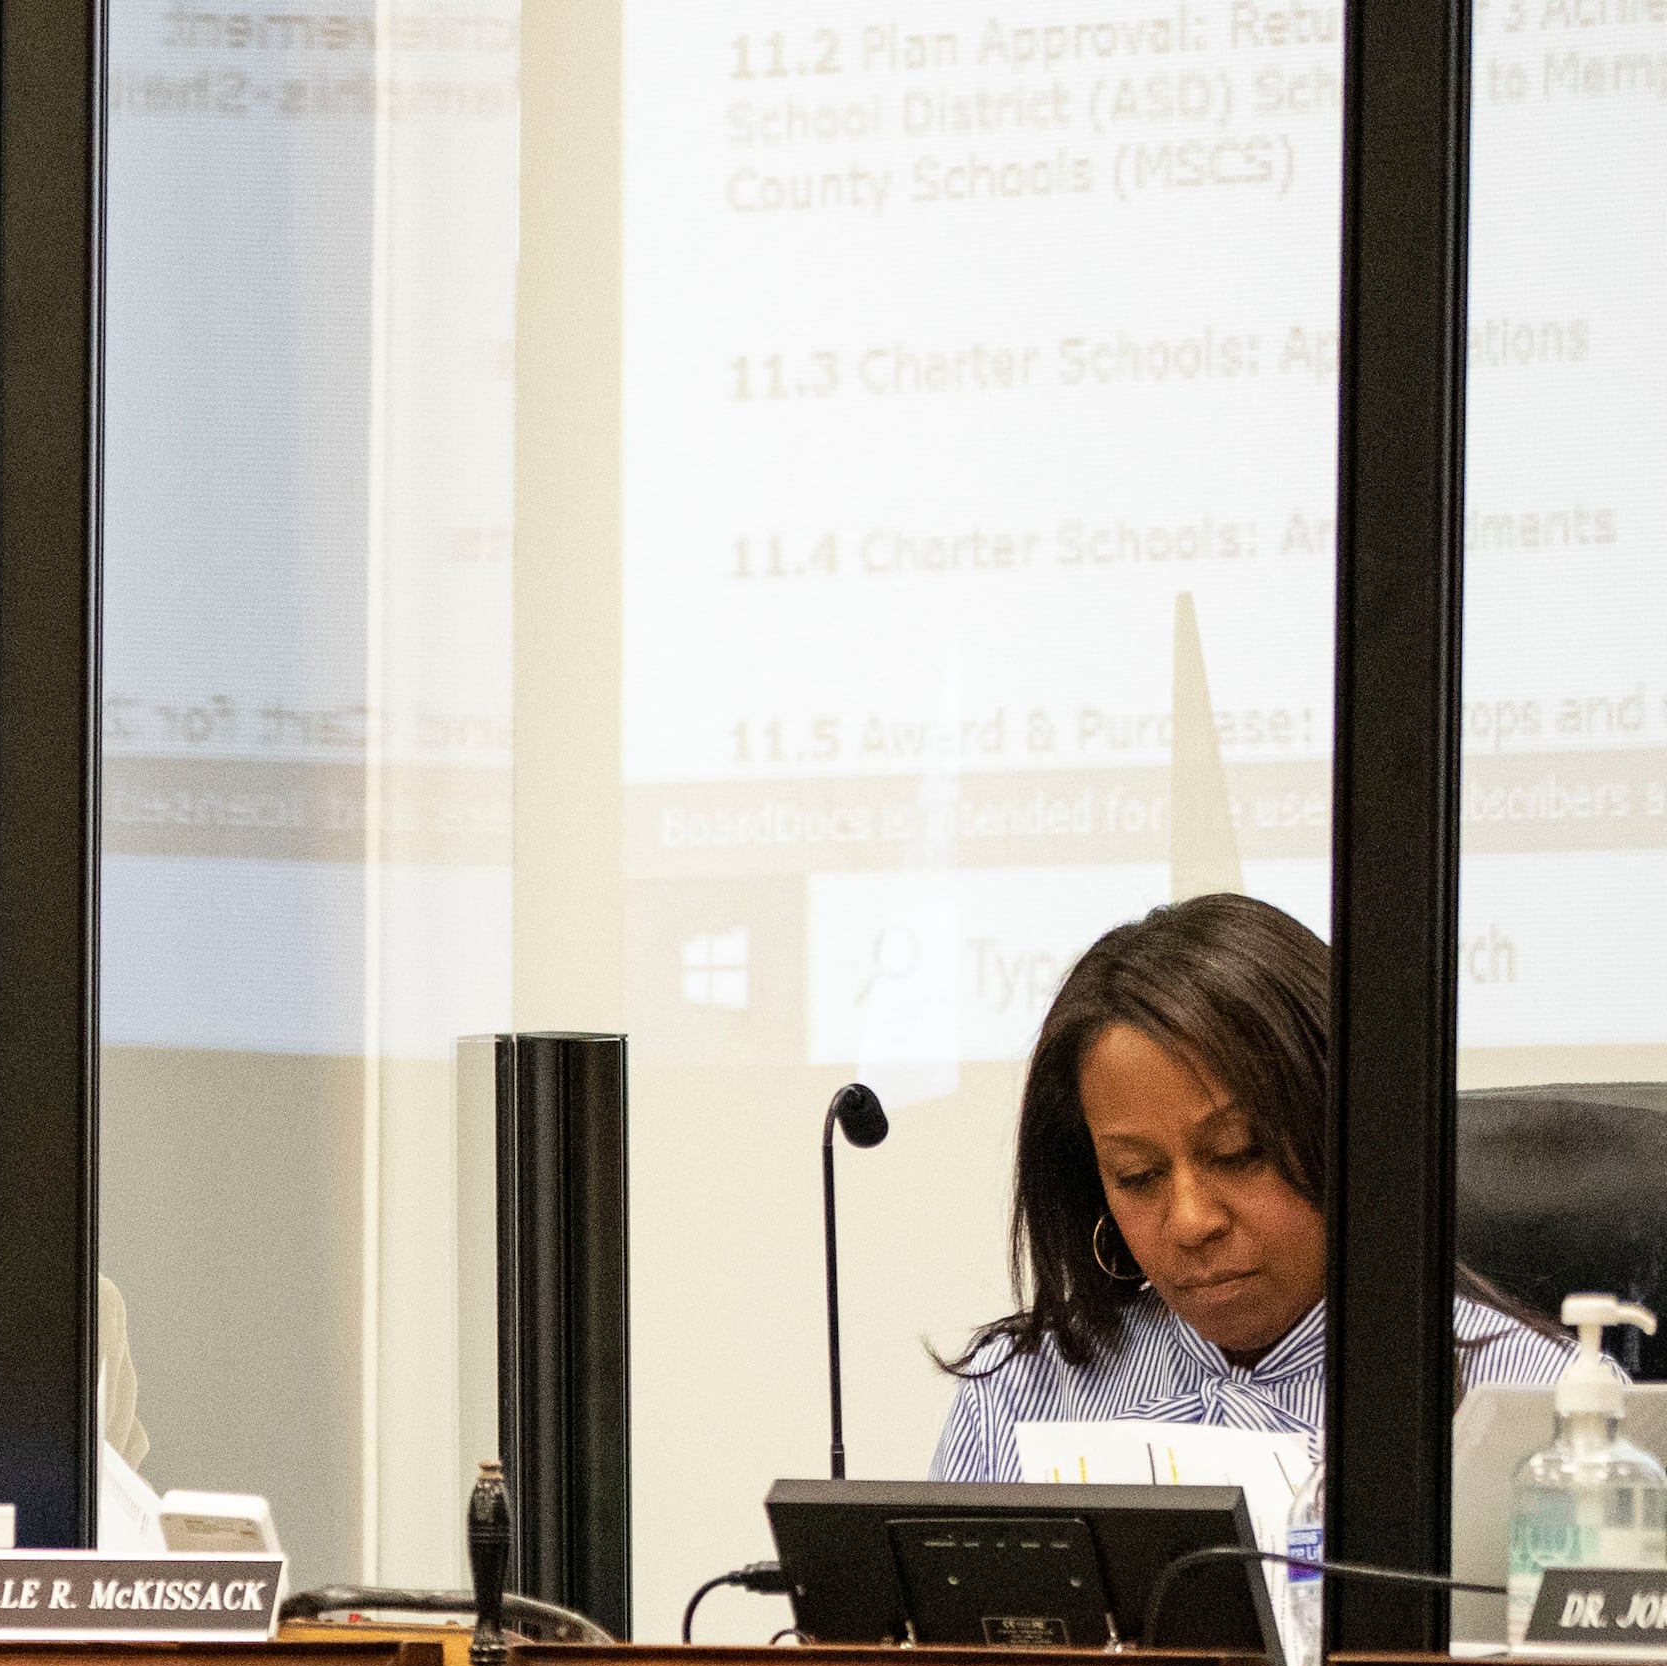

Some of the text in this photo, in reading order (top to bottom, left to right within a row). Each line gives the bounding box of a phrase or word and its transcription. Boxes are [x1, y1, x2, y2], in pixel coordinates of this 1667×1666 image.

[728, 27, 844, 81] 11.2
[860, 17, 960, 71] Plan
[972, 4, 1209, 72] Approval:
[724, 88, 886, 150] School
[900, 76, 1072, 140] District
[1088, 70, 1234, 136] (ASD)
[725, 132, 1294, 218] County Schools (MSCS)
[727, 351, 842, 402] 11.3
[857, 341, 1041, 398] Charter
[1055, 323, 1262, 386] Schools:
[730, 528, 840, 580] 11.4
[858, 521, 1042, 574] Charter
[1055, 511, 1260, 566] Schools:
[727, 715, 842, 764] 11.5
[858, 706, 1008, 759] Award
[1026, 706, 1058, 756] &
[1555, 682, 1647, 734] and
[47, 1579, 78, 1610] R.
[88, 1579, 267, 1611] McKISSACK
[1559, 1591, 1608, 1629] DR.
